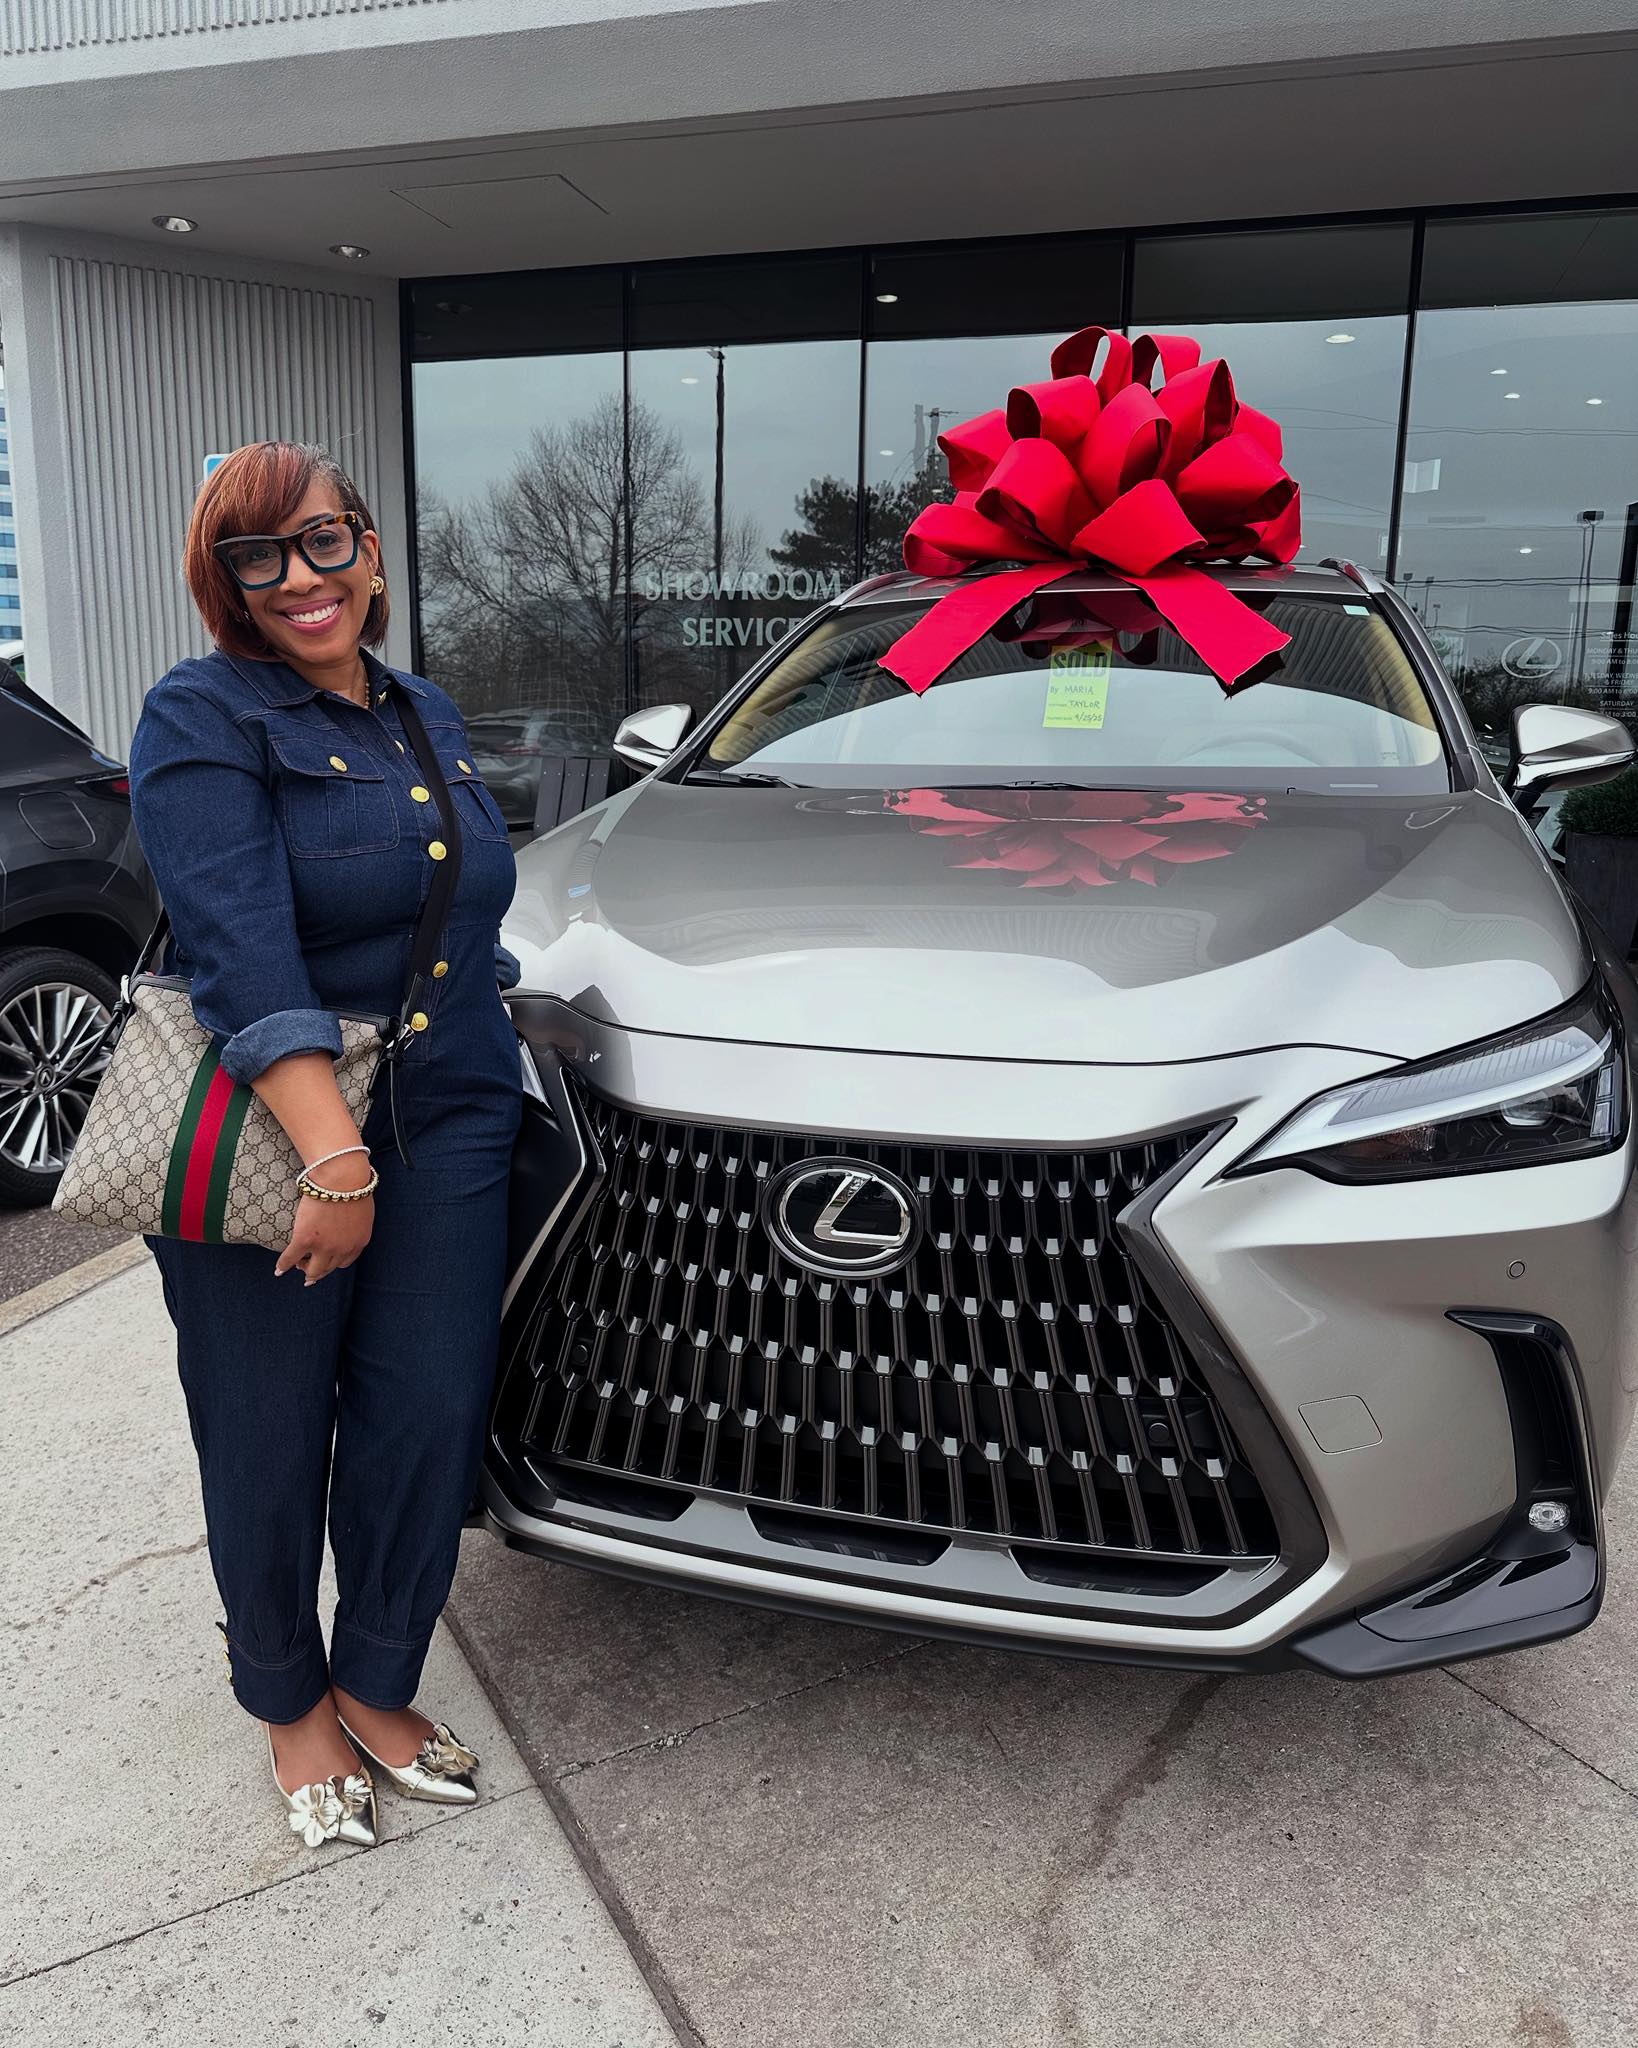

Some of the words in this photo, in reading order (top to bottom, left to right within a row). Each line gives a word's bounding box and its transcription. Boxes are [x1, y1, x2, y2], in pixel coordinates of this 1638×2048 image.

[646, 571, 841, 601] SHOWROOM
[1053, 652, 1107, 677] SOLD
[1065, 686, 1093, 695] MARIA
[1070, 700, 1101, 710] TAYLOR
